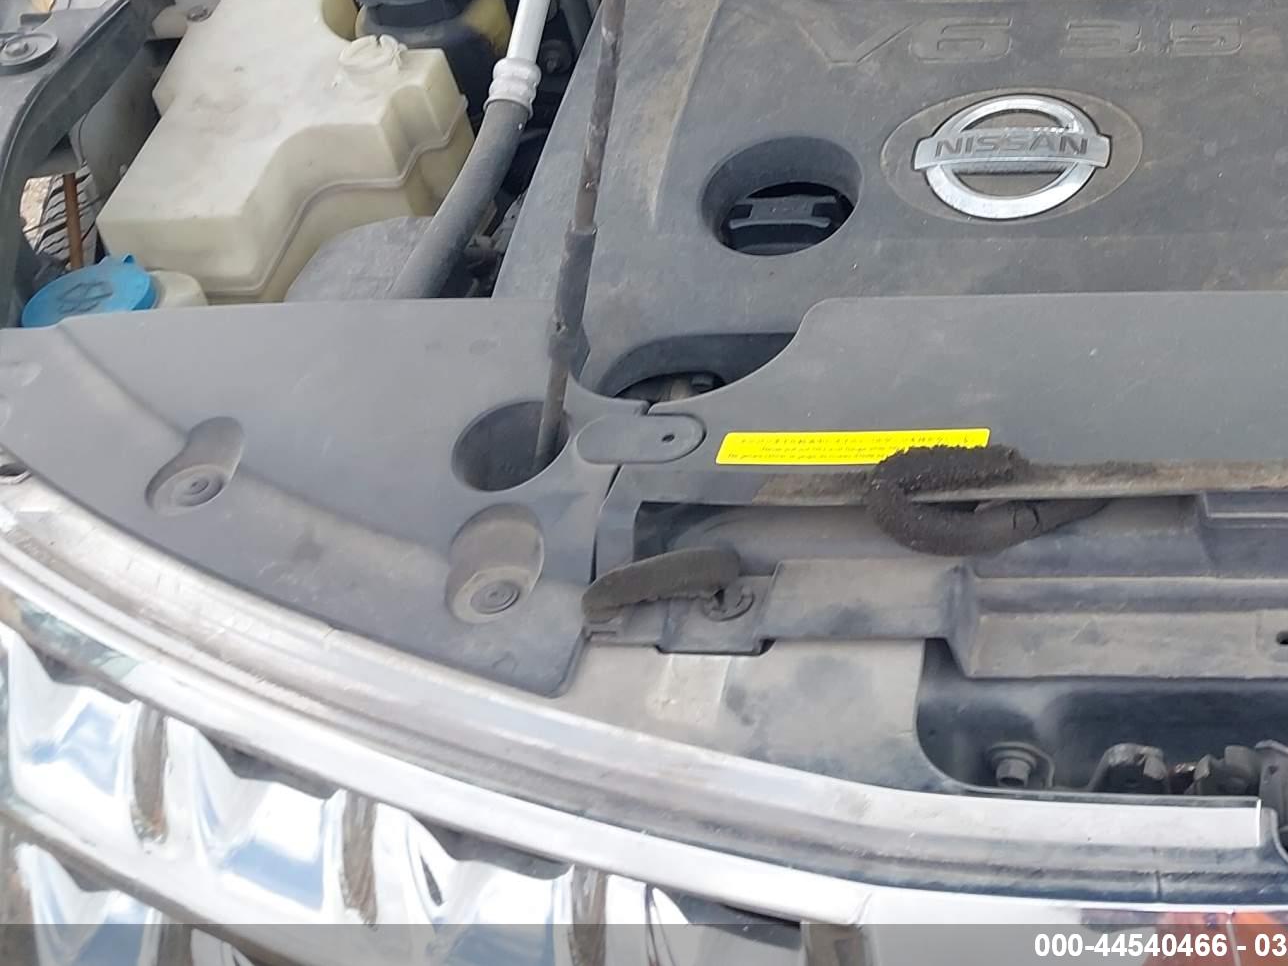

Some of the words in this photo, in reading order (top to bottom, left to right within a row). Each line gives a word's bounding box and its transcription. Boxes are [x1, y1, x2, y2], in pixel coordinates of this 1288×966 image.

[796, 17, 1014, 66] V6
[1060, 17, 1243, 56] 3.5
[934, 134, 1089, 157] NISSAN
